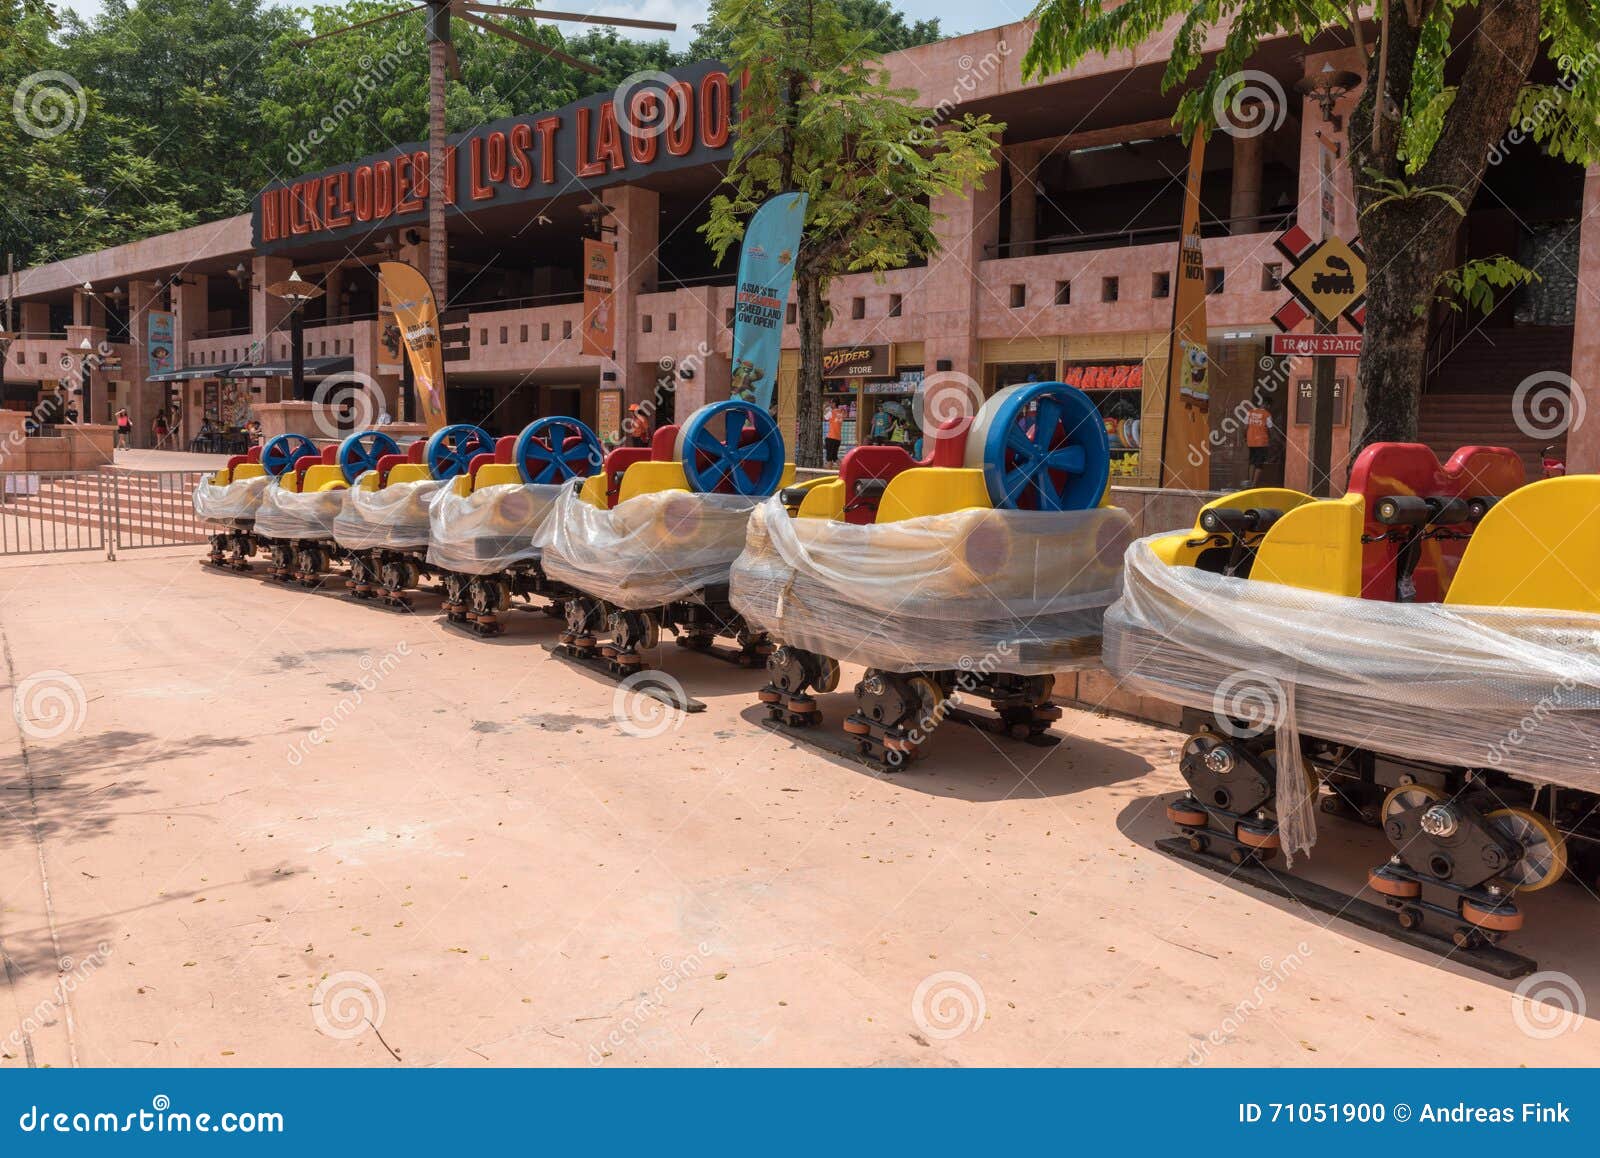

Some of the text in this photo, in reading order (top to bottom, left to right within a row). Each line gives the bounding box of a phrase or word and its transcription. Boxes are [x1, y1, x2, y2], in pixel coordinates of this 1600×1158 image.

[470, 116, 560, 200] LOST
[1282, 338, 1318, 351] TRAIN
[848, 365, 873, 375] STORE
